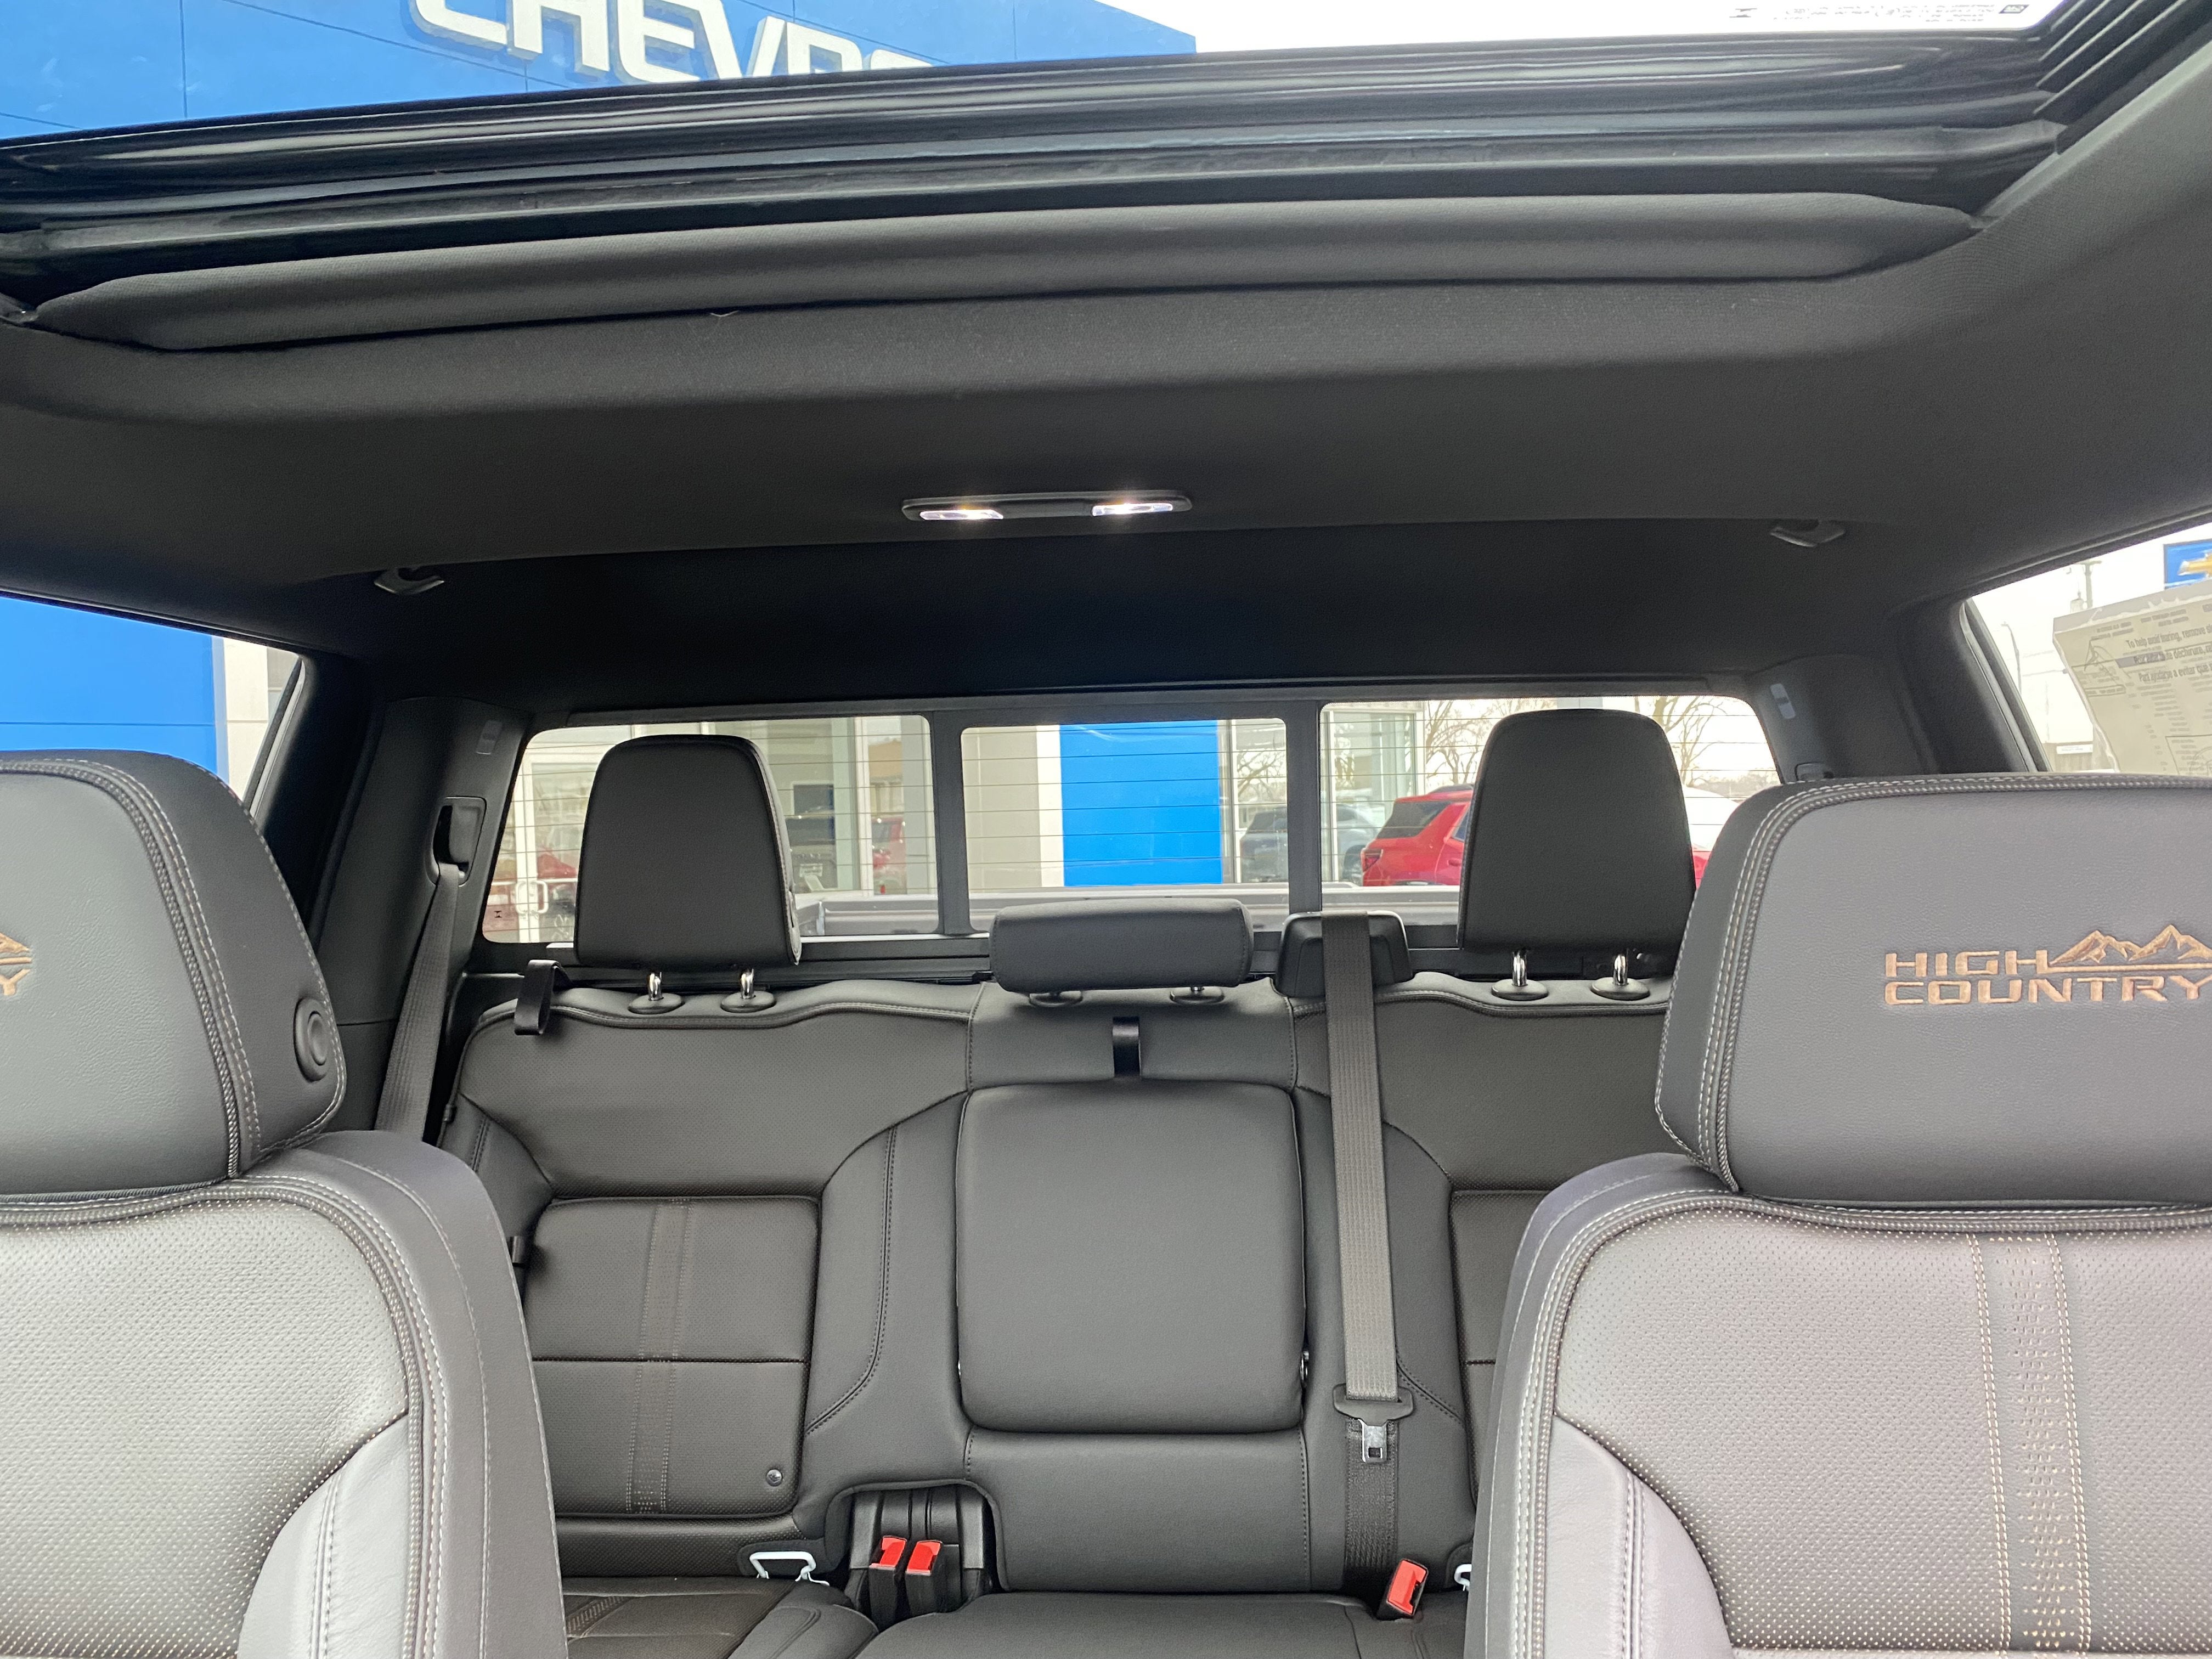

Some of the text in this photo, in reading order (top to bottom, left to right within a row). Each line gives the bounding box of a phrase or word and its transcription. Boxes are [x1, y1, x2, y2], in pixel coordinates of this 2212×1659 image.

[411, 0, 933, 82] HEV
[2125, 640, 2136, 648] To
[1885, 950, 2048, 977] HIGH
[1884, 975, 2212, 1005] COUNTRY
